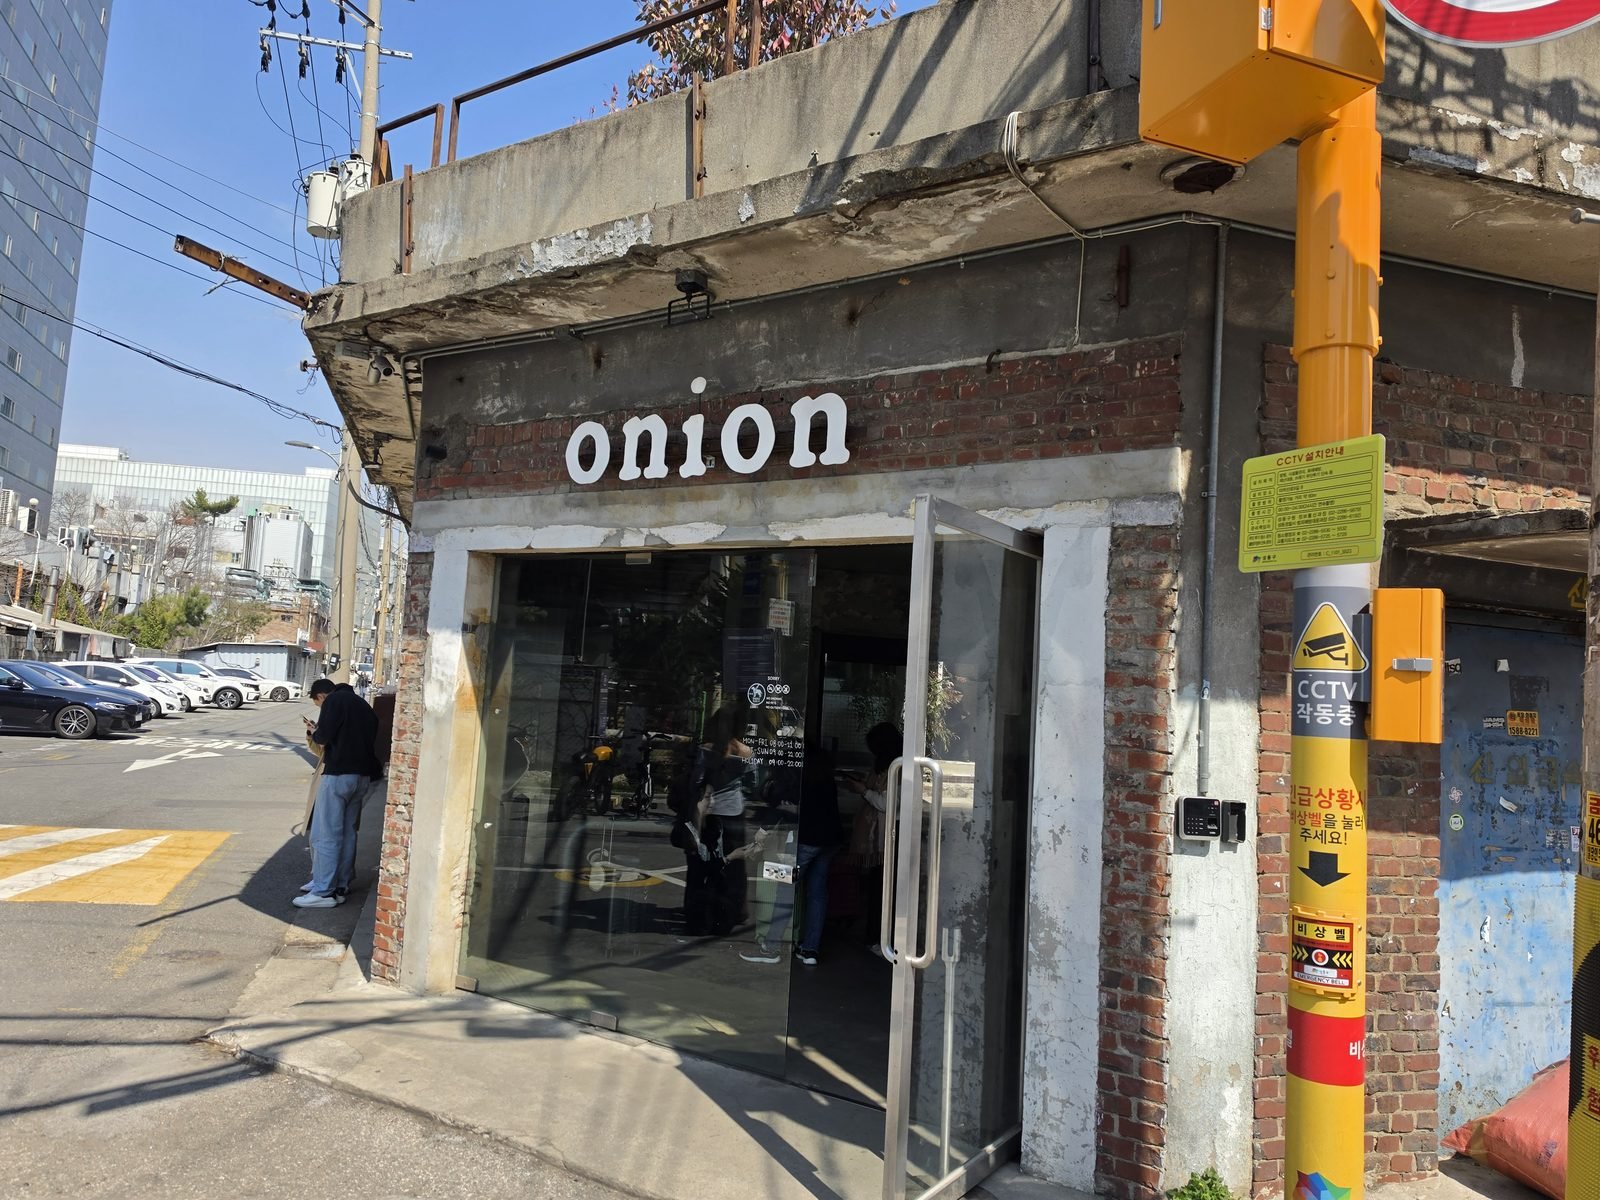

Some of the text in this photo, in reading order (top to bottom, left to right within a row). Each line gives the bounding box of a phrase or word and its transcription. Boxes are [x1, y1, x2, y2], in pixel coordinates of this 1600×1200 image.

[565, 376, 850, 485] onion
[1297, 680, 1357, 700] CCTV
[1296, 703, 1356, 726] 작동중
[1341, 815, 1364, 830] 눌러
[1300, 828, 1347, 845] 주세요!
[1296, 972, 1345, 986] EMERGENCY BELL
